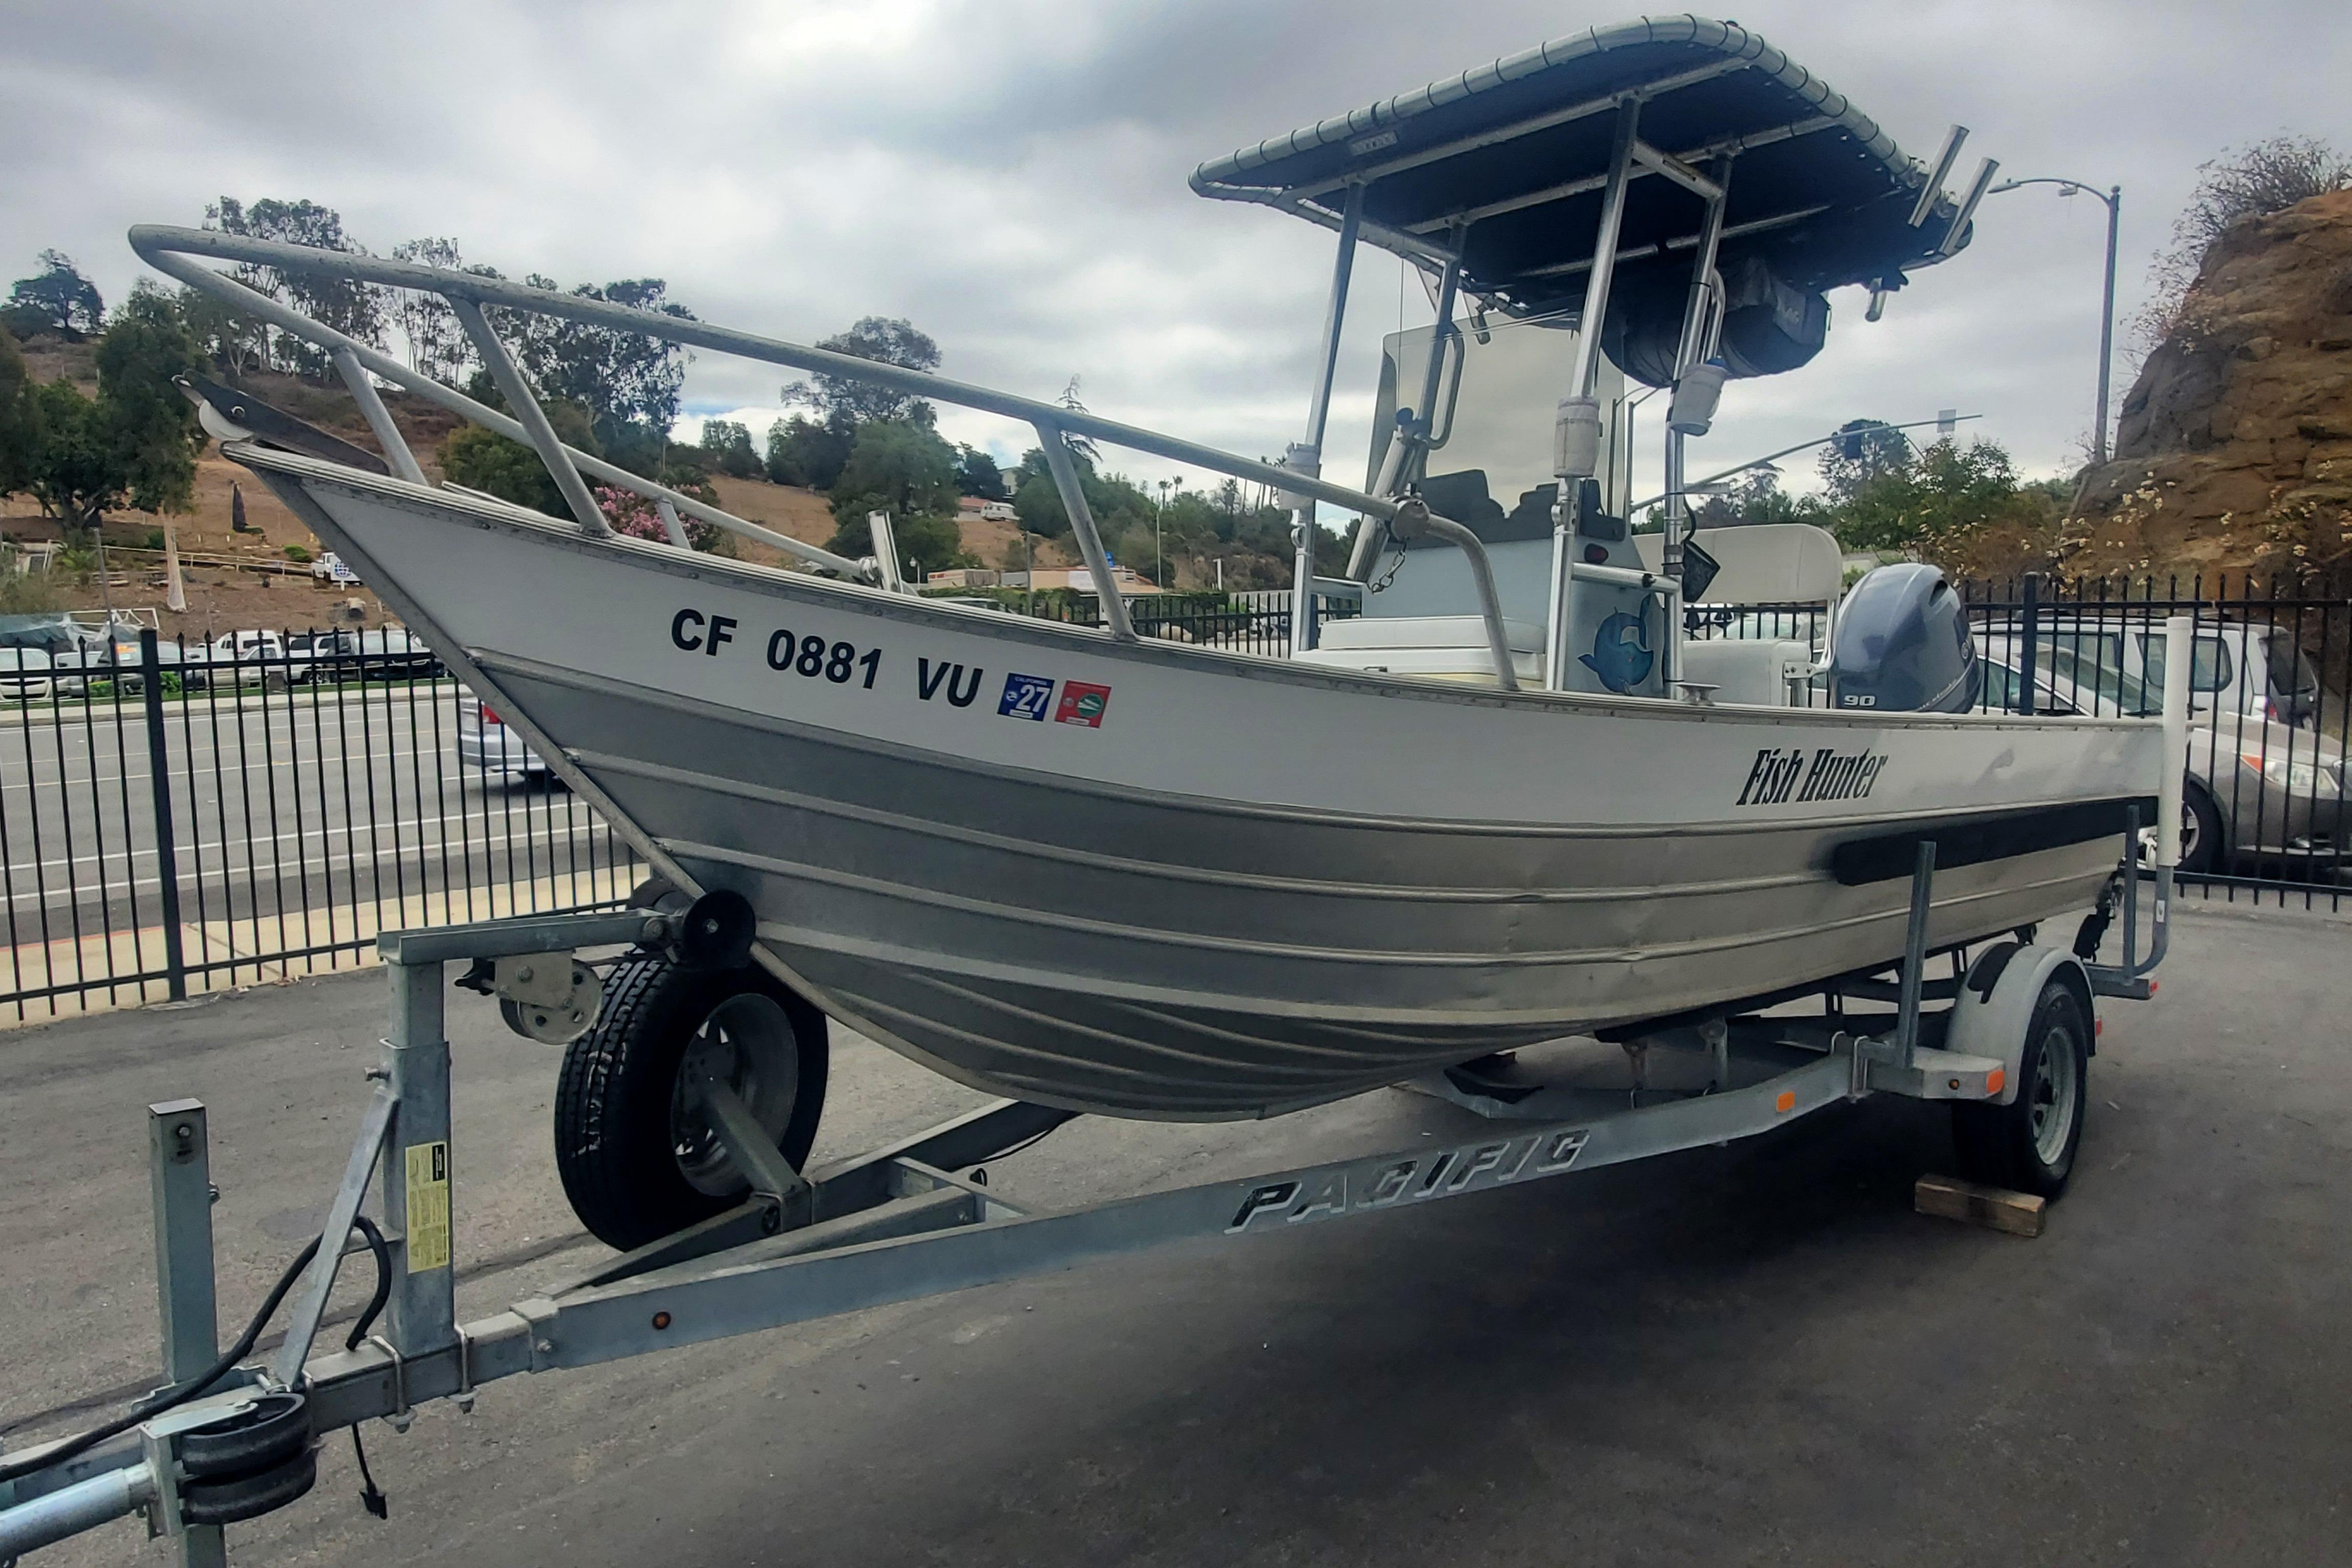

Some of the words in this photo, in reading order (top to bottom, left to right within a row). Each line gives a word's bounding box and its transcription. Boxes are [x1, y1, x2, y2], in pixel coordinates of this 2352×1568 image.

[671, 608, 738, 656] CF
[766, 628, 882, 690] 0881
[918, 657, 984, 708] VU
[1016, 684, 1050, 713] 27
[1844, 695, 1876, 707] 90
[1736, 748, 1804, 805] Fish
[1796, 747, 1888, 803] Hunter
[1224, 1129, 1590, 1234] PACIFIC
